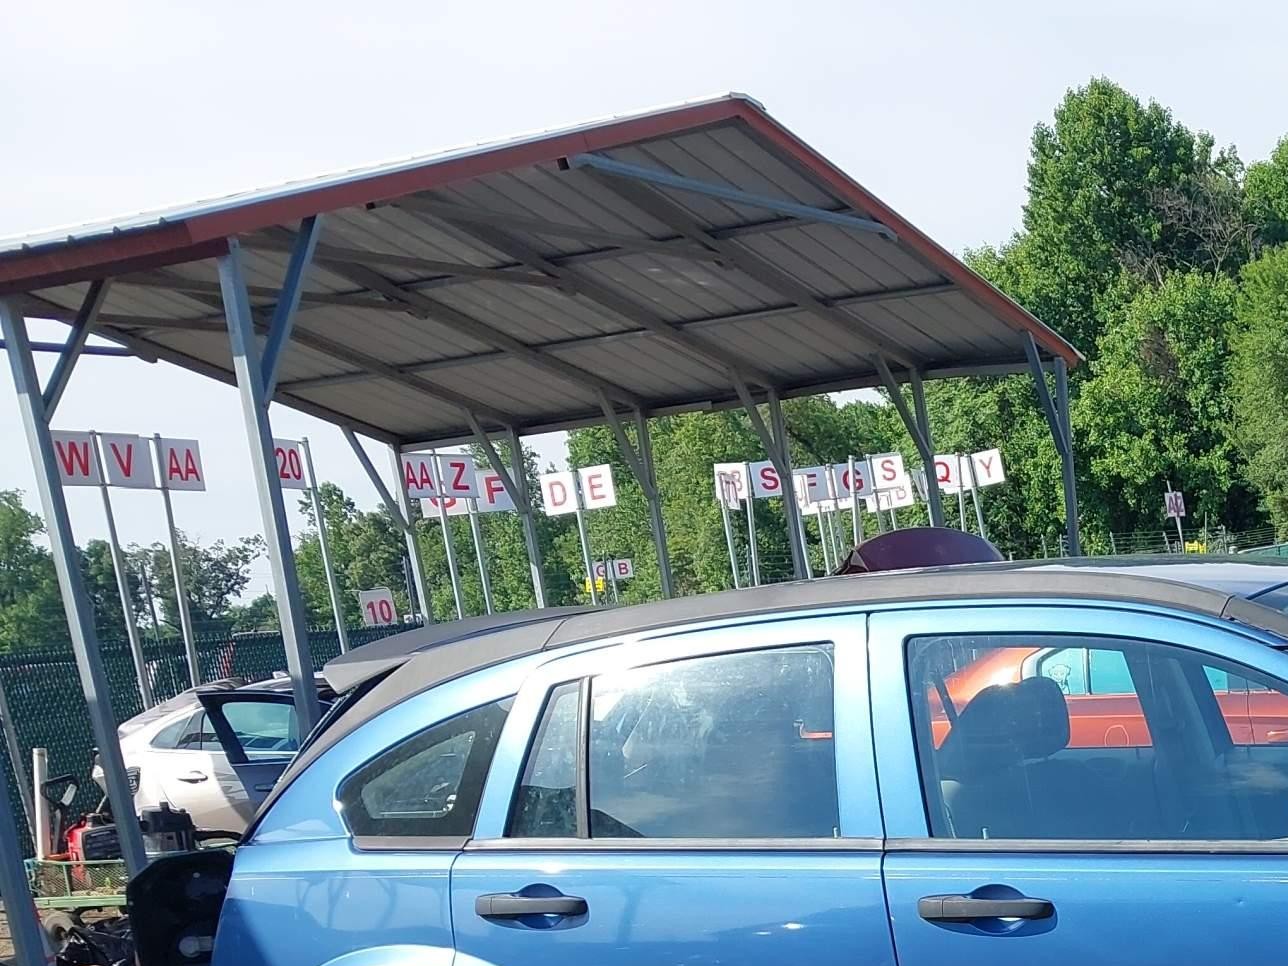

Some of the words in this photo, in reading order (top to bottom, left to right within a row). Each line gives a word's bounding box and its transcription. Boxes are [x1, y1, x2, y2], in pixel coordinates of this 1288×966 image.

[55, 440, 90, 477] W
[111, 442, 133, 478] V
[168, 447, 201, 482] AA
[274, 447, 302, 481] 20
[881, 459, 897, 481] S
[979, 456, 993, 479] Y
[405, 461, 434, 490] AA
[449, 462, 470, 490] Z
[760, 467, 780, 490] S
[842, 468, 864, 491] G
[934, 461, 951, 483] Q
[485, 476, 505, 504] F
[549, 480, 568, 506] D
[588, 474, 607, 501] E
[618, 562, 629, 575] B
[367, 599, 392, 624] 10
